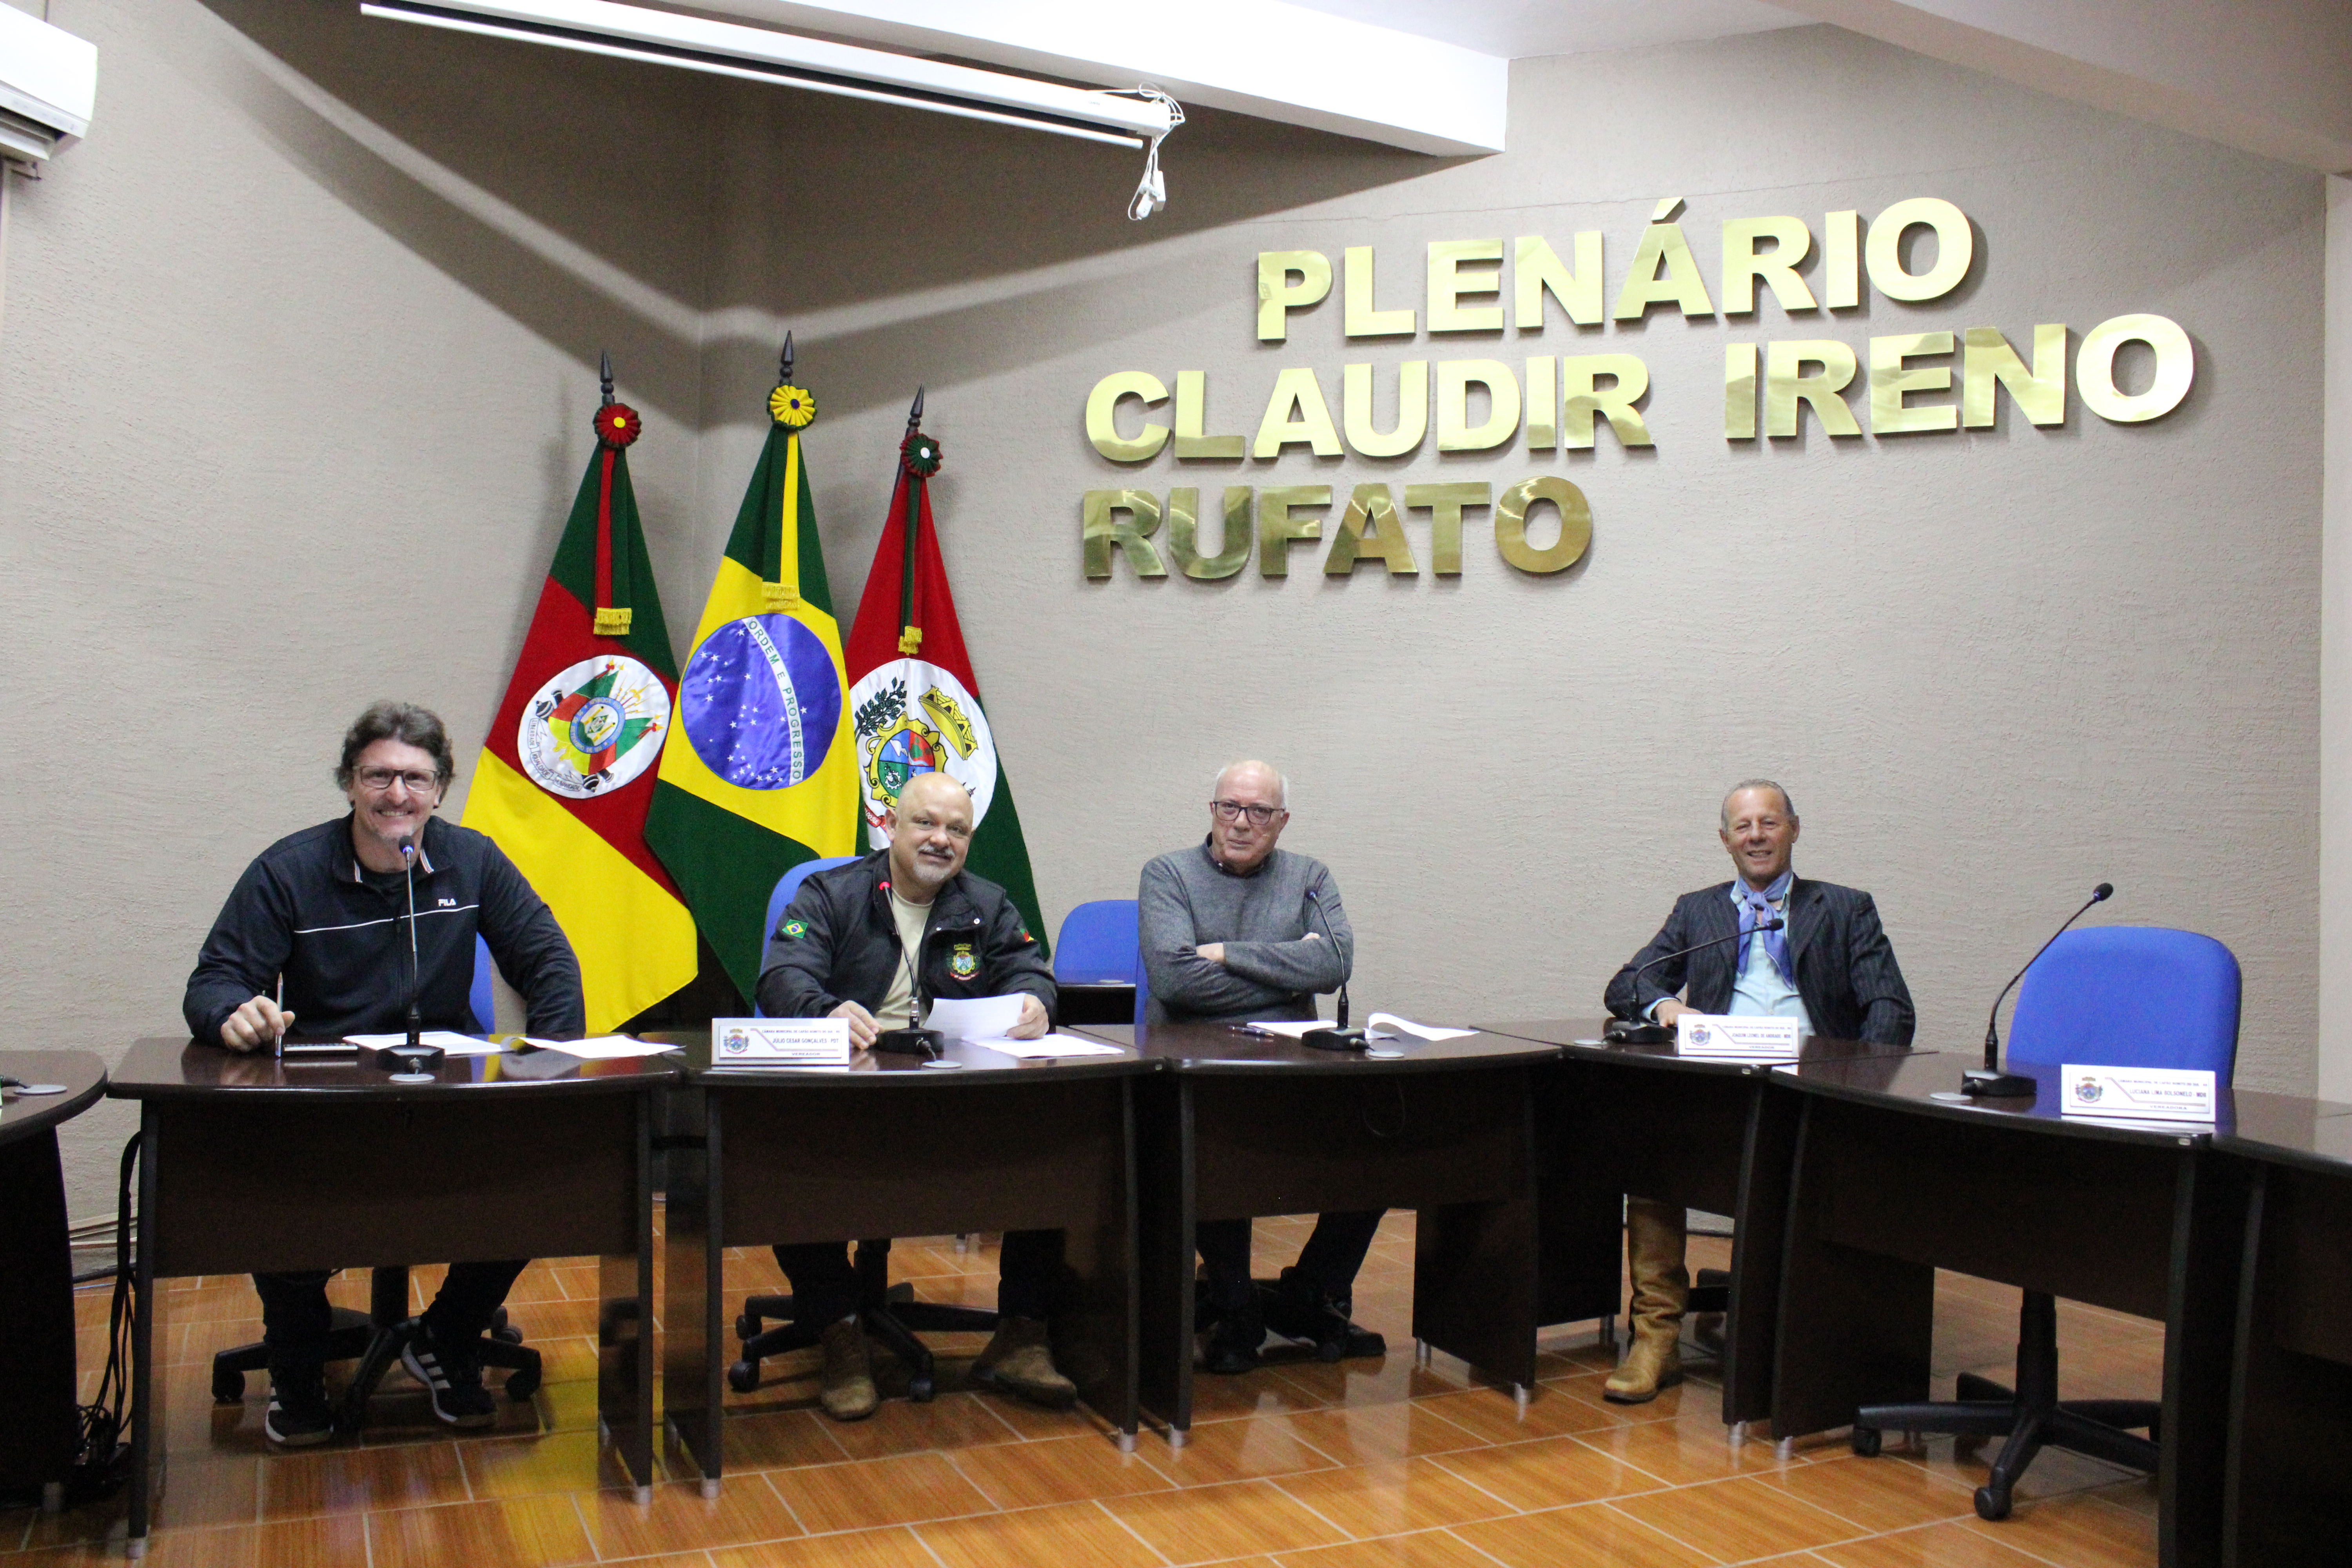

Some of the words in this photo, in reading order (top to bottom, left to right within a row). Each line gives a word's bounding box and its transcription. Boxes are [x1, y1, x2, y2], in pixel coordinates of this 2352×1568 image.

[1258, 197, 1973, 340] PLENÁRIO
[1084, 353, 1655, 462] CLAUDIR
[1724, 313, 2196, 441] IRENO
[1082, 475, 1592, 578] RUFATO
[749, 621, 780, 664] ORDEM
[782, 687, 802, 779] PROGRESSO
[532, 753, 550, 777] IGUALDADE
[438, 898, 457, 906] FILA
